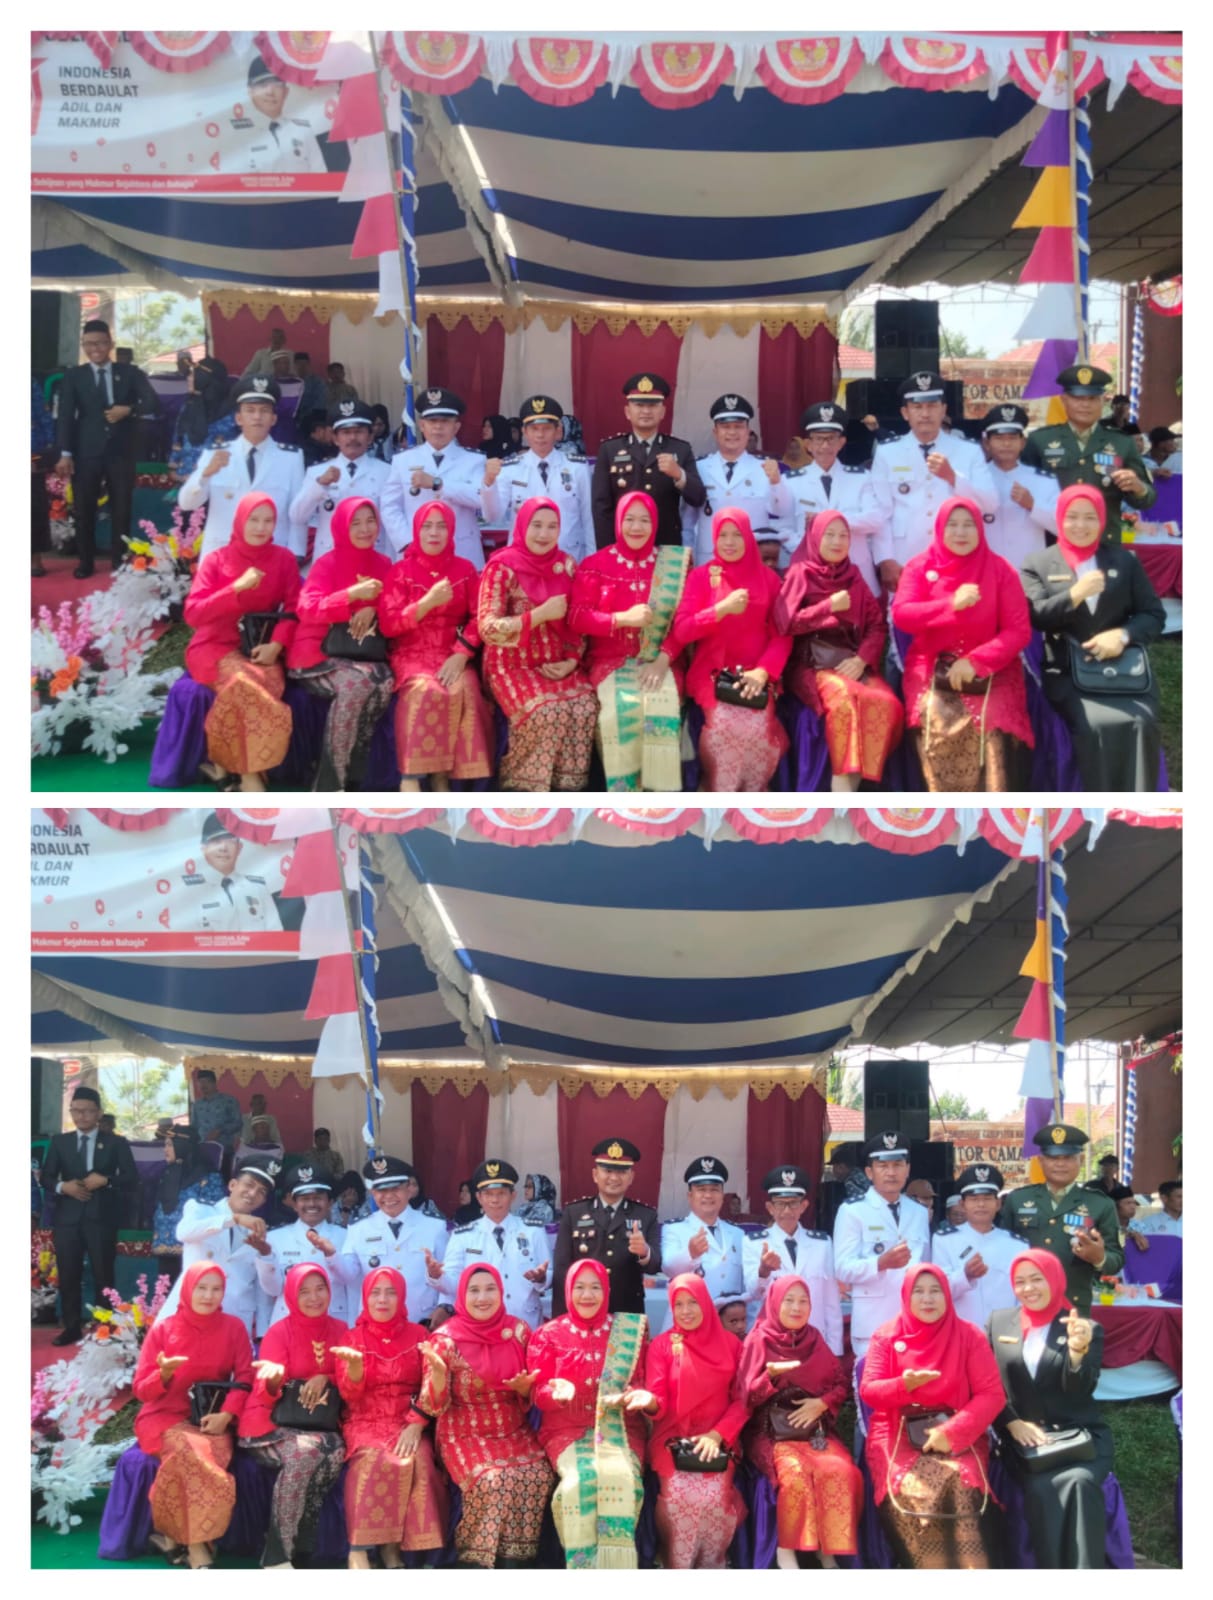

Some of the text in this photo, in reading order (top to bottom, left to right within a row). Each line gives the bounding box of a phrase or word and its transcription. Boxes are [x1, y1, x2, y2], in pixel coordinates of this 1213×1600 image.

[58, 66, 132, 79] INDONESIA
[60, 84, 140, 98] BERDAULAT
[60, 102, 123, 113] ADIL DAN
[57, 116, 121, 129] MAKMUR
[44, 861, 73, 871] DAN
[100, 937, 114, 947] dan
